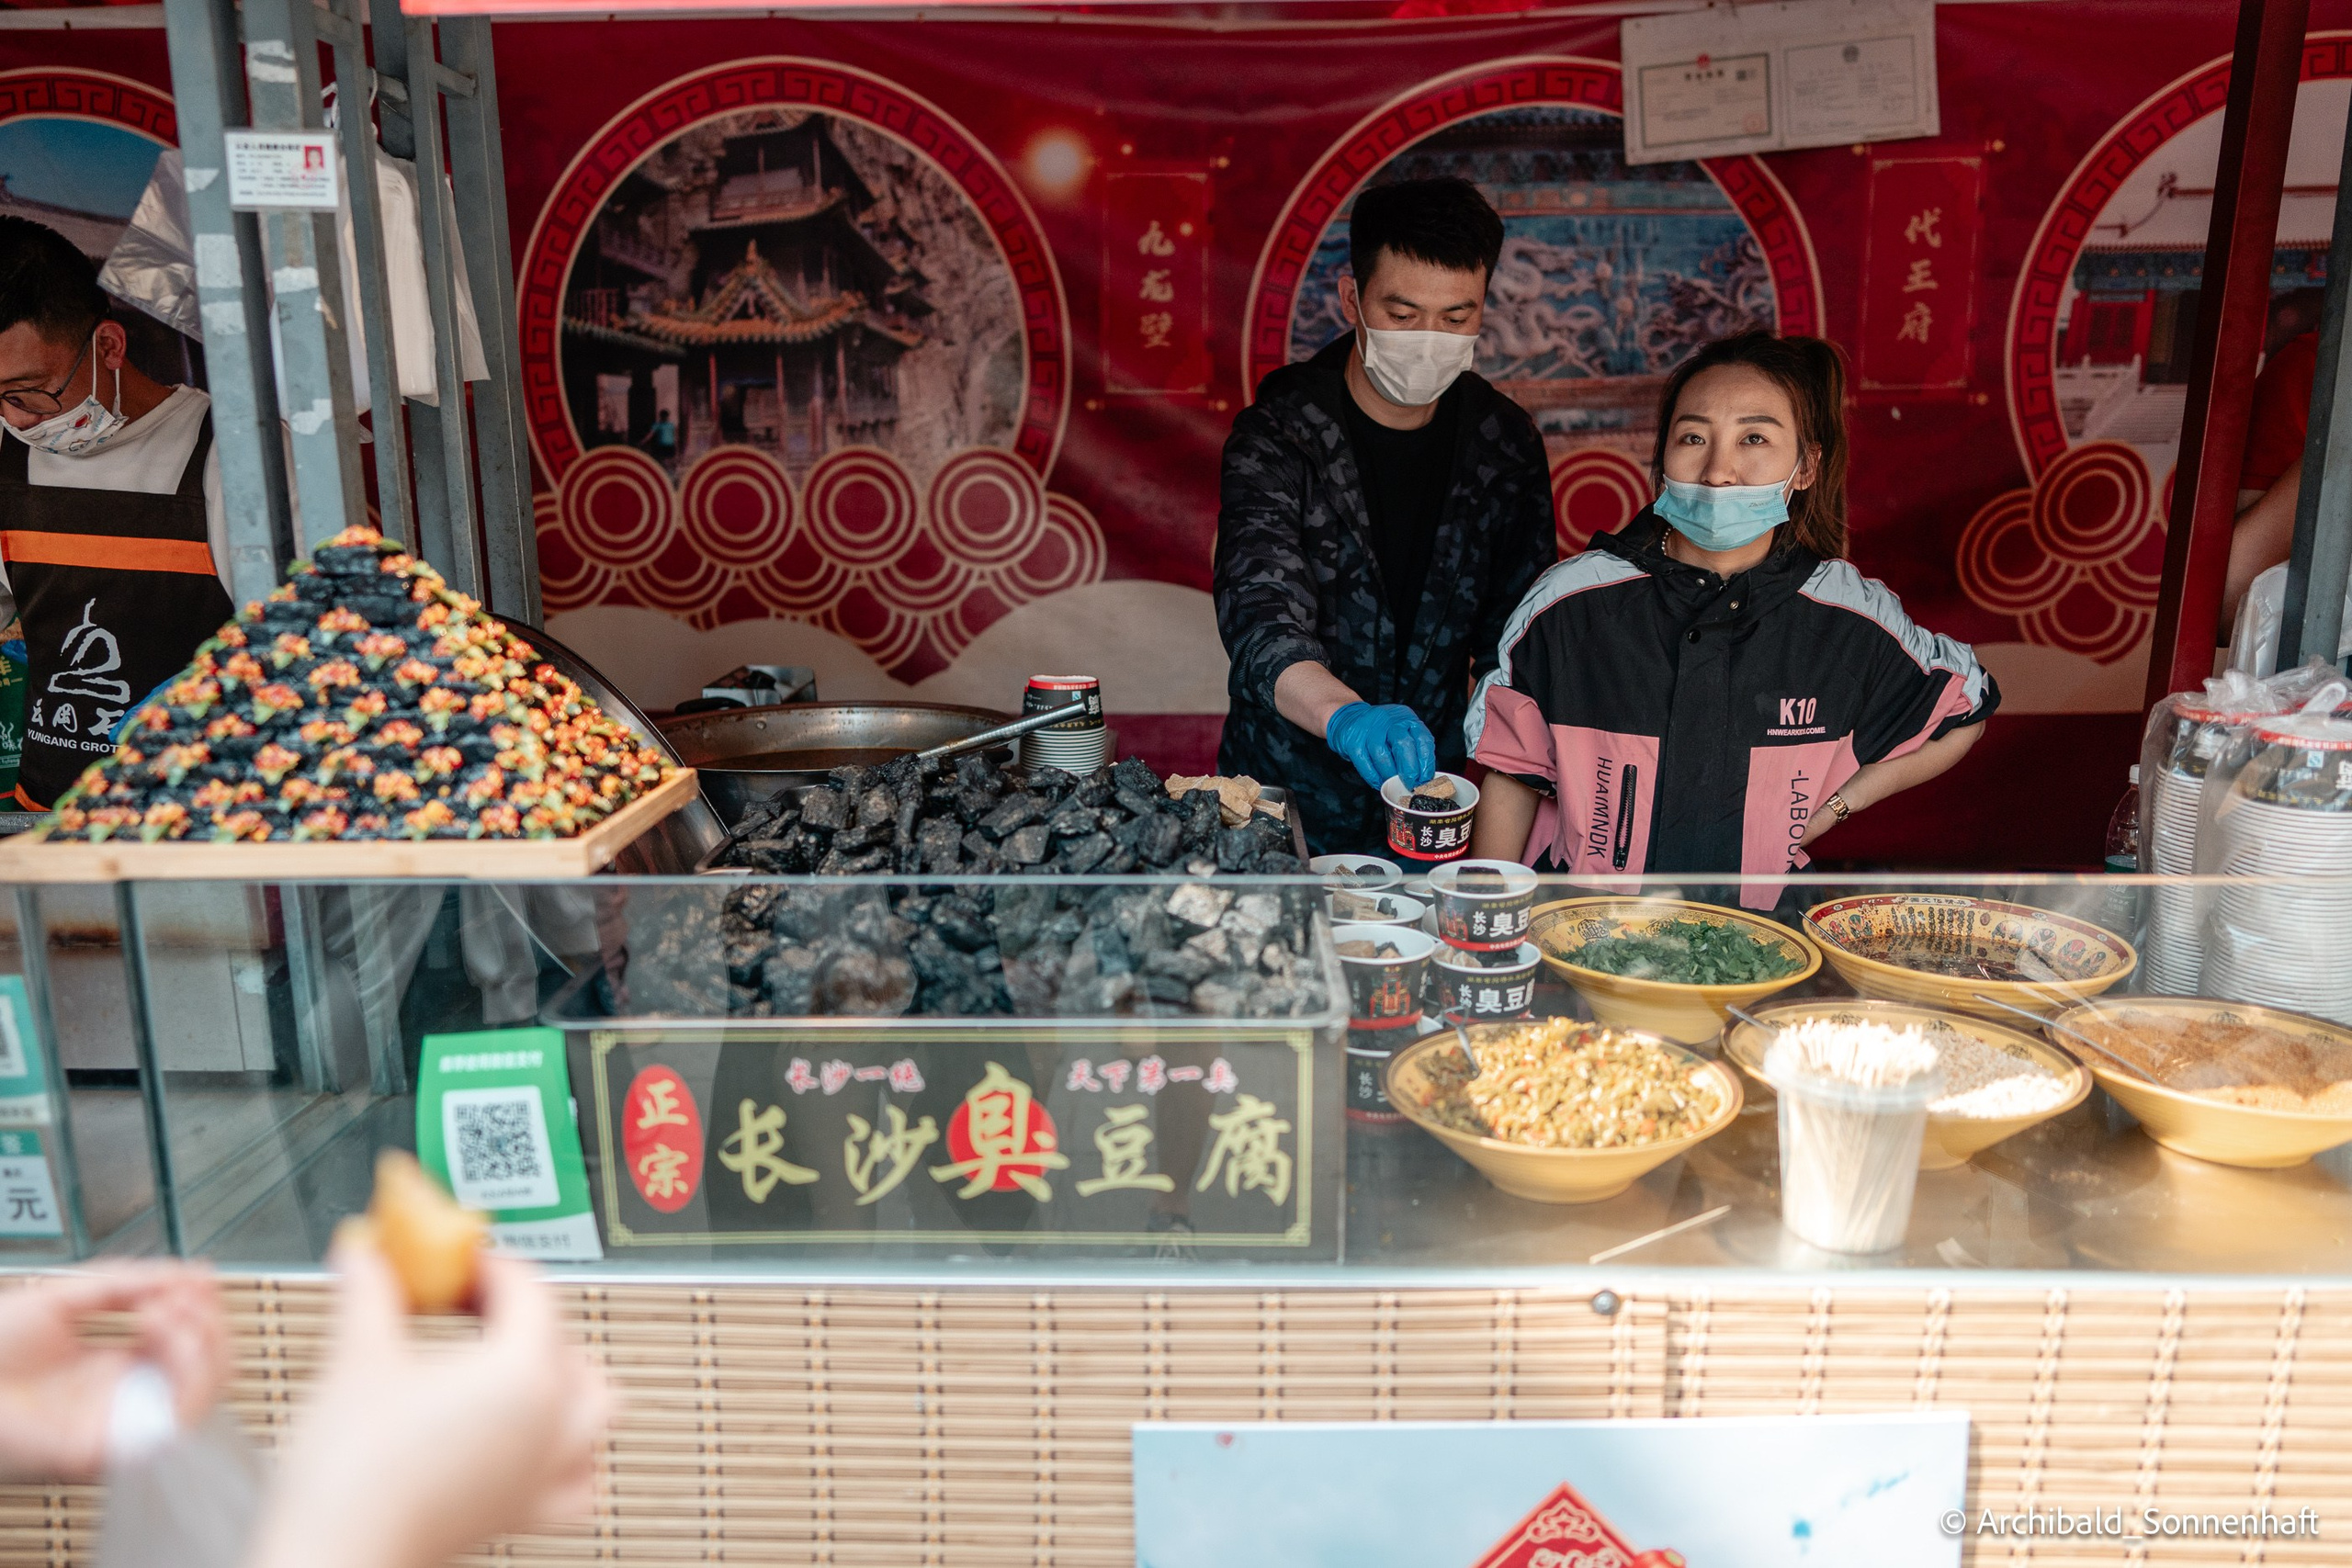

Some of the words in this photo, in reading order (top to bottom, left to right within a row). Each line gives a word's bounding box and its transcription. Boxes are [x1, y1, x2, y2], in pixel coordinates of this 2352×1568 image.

[1896, 207, 1943, 344] 代王府
[1780, 698, 1817, 726] K10
[28, 728, 77, 750] YUNGANG
[80, 741, 123, 754] GROT
[1420, 826, 1433, 847] 长沙
[1473, 910, 1487, 936] 长沙
[637, 1078, 689, 1199] 正宗
[718, 1061, 1293, 1206] 长沙臭豆腐
